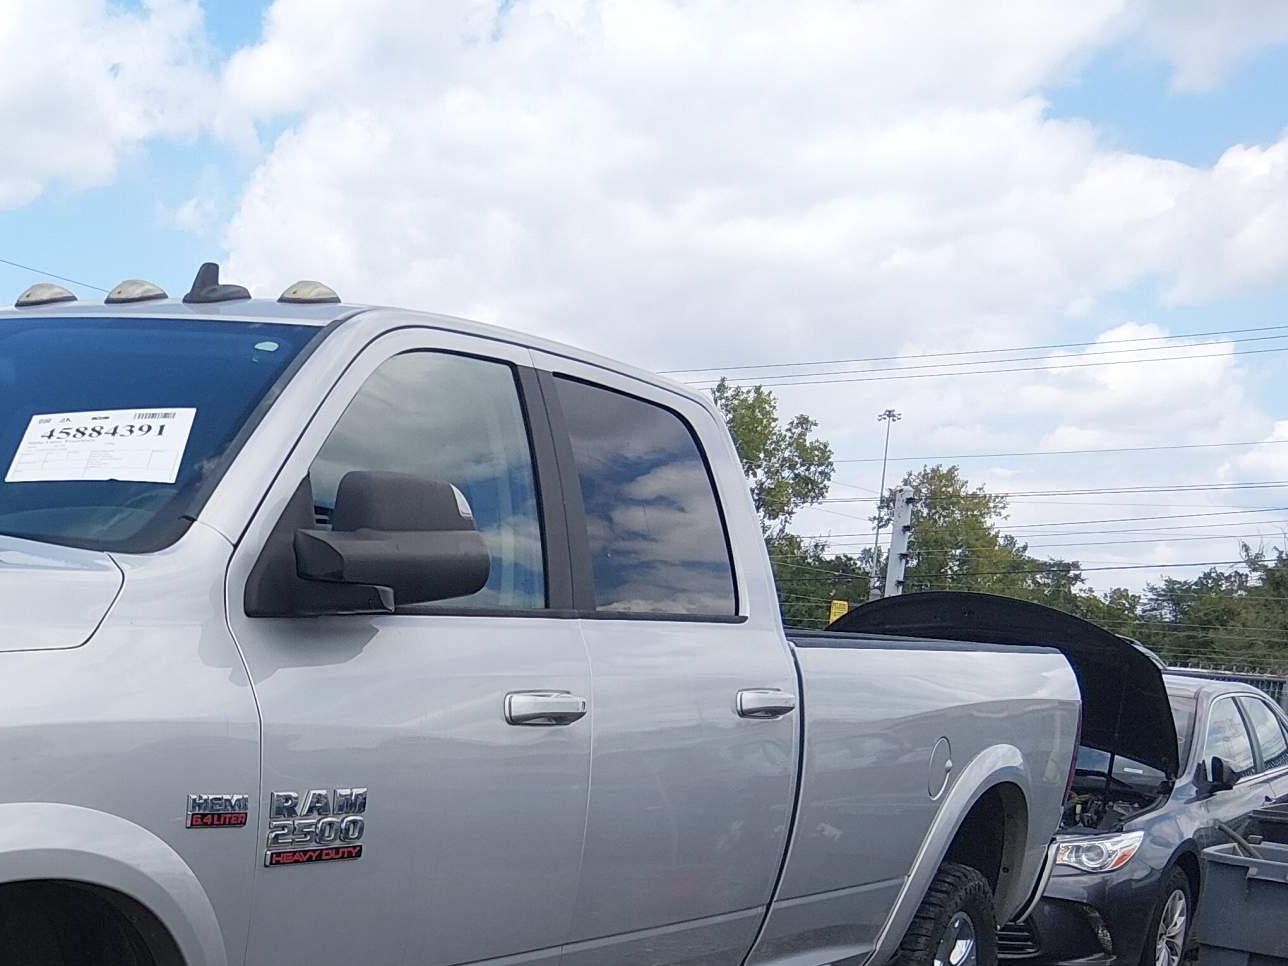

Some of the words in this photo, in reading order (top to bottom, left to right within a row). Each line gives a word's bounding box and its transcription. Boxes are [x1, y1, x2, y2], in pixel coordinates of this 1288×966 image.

[40, 424, 166, 441] 45884391
[187, 794, 249, 813] HEMI
[270, 787, 368, 818] RAM
[192, 815, 212, 826] 6.4
[214, 813, 247, 825] LITER
[267, 816, 365, 847] 2500
[272, 850, 318, 864] HEAVY
[322, 847, 361, 860] DUTY
